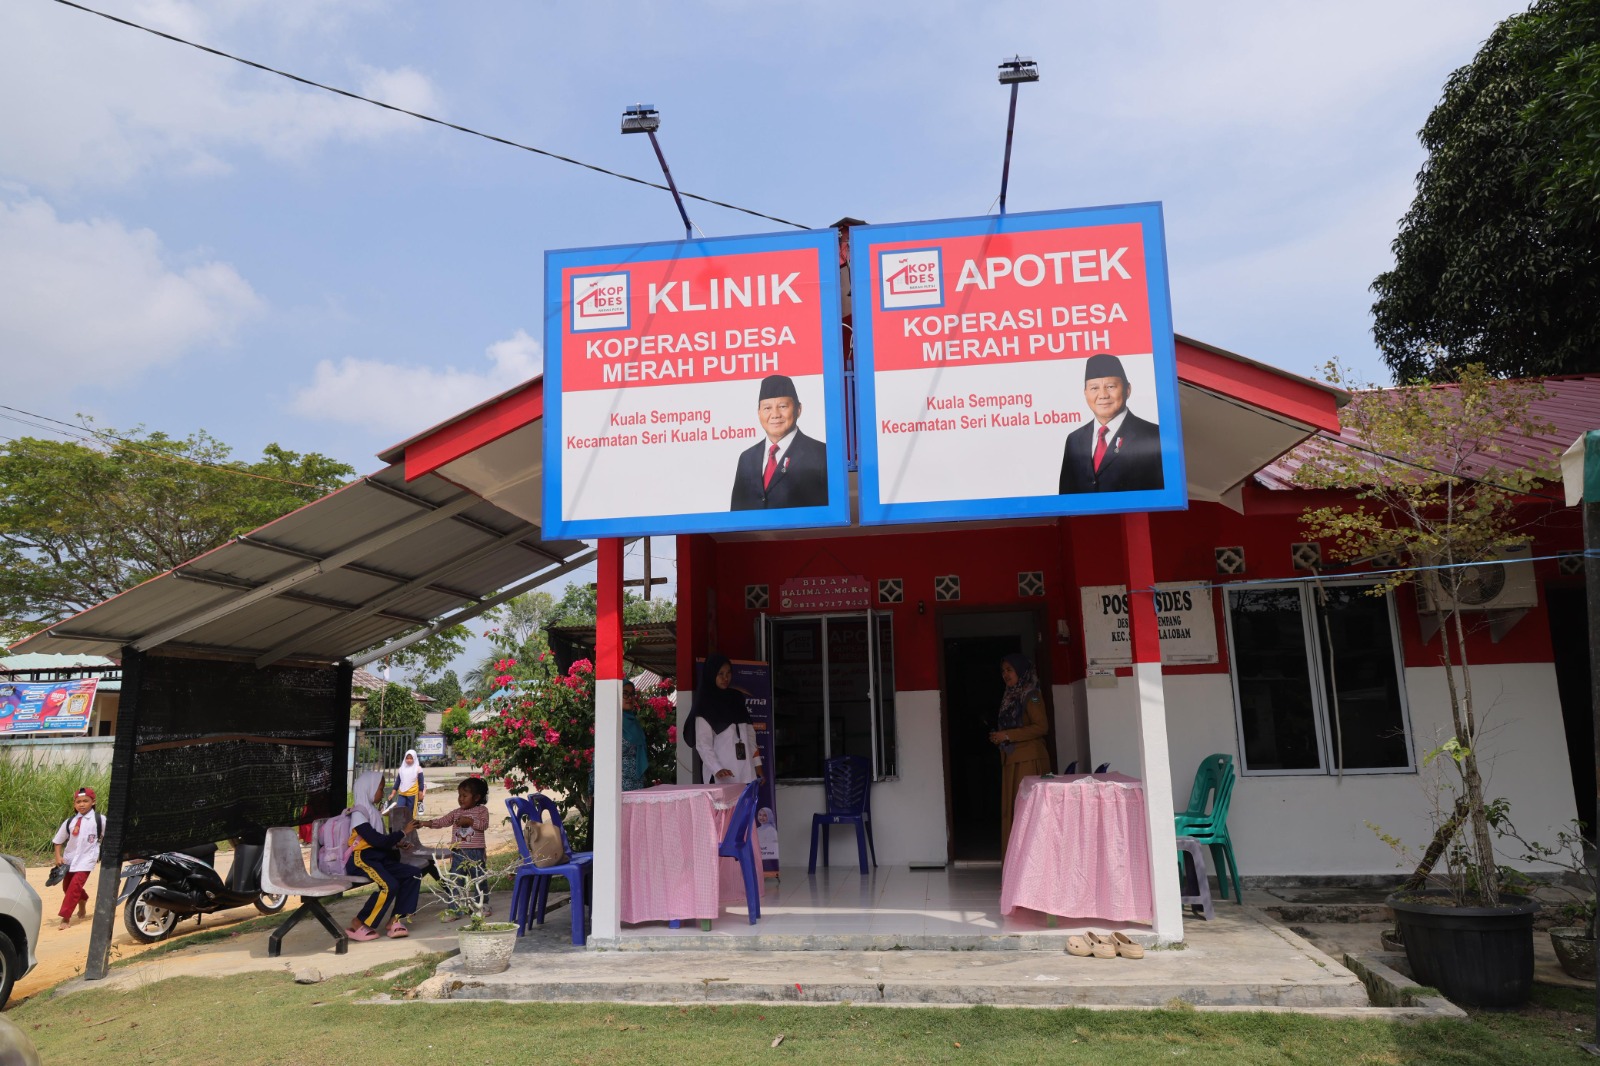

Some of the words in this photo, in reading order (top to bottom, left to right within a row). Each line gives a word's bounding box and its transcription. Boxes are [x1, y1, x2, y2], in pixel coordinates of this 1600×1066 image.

[909, 263, 935, 273] KOP
[909, 273, 935, 284] DES
[955, 246, 1132, 292] APOTEK
[599, 286, 624, 296] KOP
[648, 272, 803, 315] KLINIK
[599, 297, 622, 307] DES
[903, 308, 1042, 337] KOPERASI
[1051, 303, 1128, 327] DESA
[586, 331, 717, 360] KOPERASI
[725, 326, 796, 350] DESA
[922, 336, 1020, 362] MERAH
[1029, 330, 1110, 354] PUTIH
[602, 358, 694, 383] MERAH
[703, 352, 779, 376] PUTIH
[926, 394, 965, 410] Kuala
[968, 393, 1033, 409] Sempang
[610, 410, 647, 427] Kuala
[650, 408, 711, 425] Sempang
[881, 417, 956, 434] Kecamatan
[960, 414, 987, 430] Seri
[991, 411, 1030, 428] Kuala
[1034, 410, 1082, 426] Lobam
[567, 433, 638, 450] Kecamatan
[641, 430, 667, 445] Seri
[671, 427, 708, 443] Kuala
[711, 425, 756, 441] Lobam
[781, 588, 821, 597] HALIMA
[803, 578, 848, 586] BIDAN
[1102, 591, 1192, 615] POSSDES
[1158, 615, 1181, 627] EMPANG
